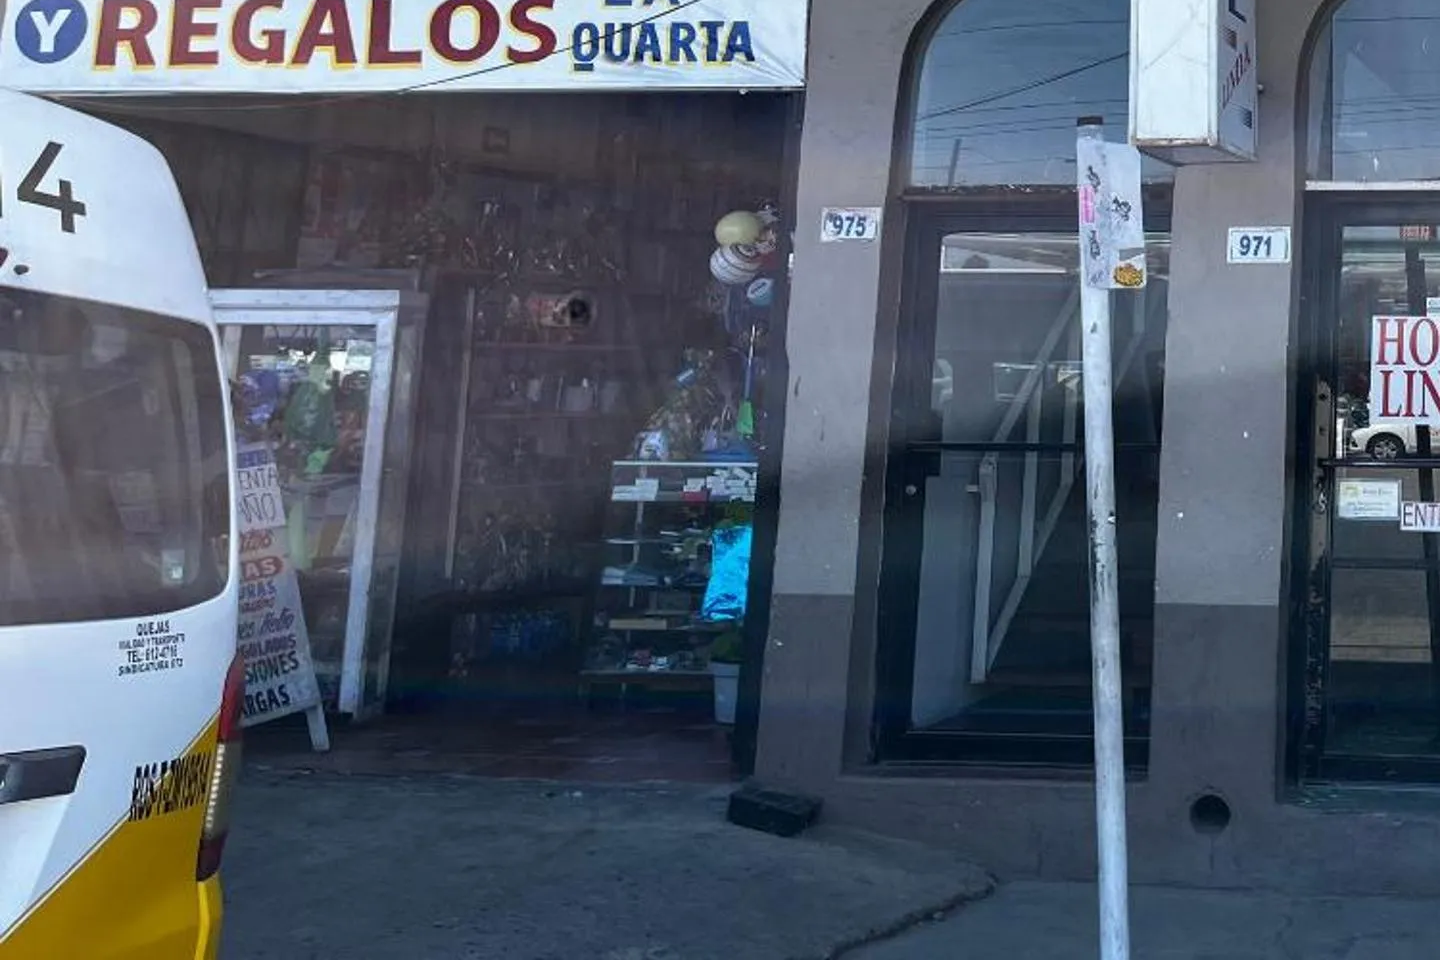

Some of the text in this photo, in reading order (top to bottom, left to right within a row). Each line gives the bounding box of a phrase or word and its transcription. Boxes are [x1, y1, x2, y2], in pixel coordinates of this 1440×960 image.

[30, 8, 71, 54] Y
[571, 20, 757, 72] QUARTA
[0, 140, 87, 234] 4
[832, 214, 866, 237] 975
[1239, 235, 1272, 256] 971
[136, 620, 169, 636] QUEJAS
[245, 649, 299, 685] SIONES
